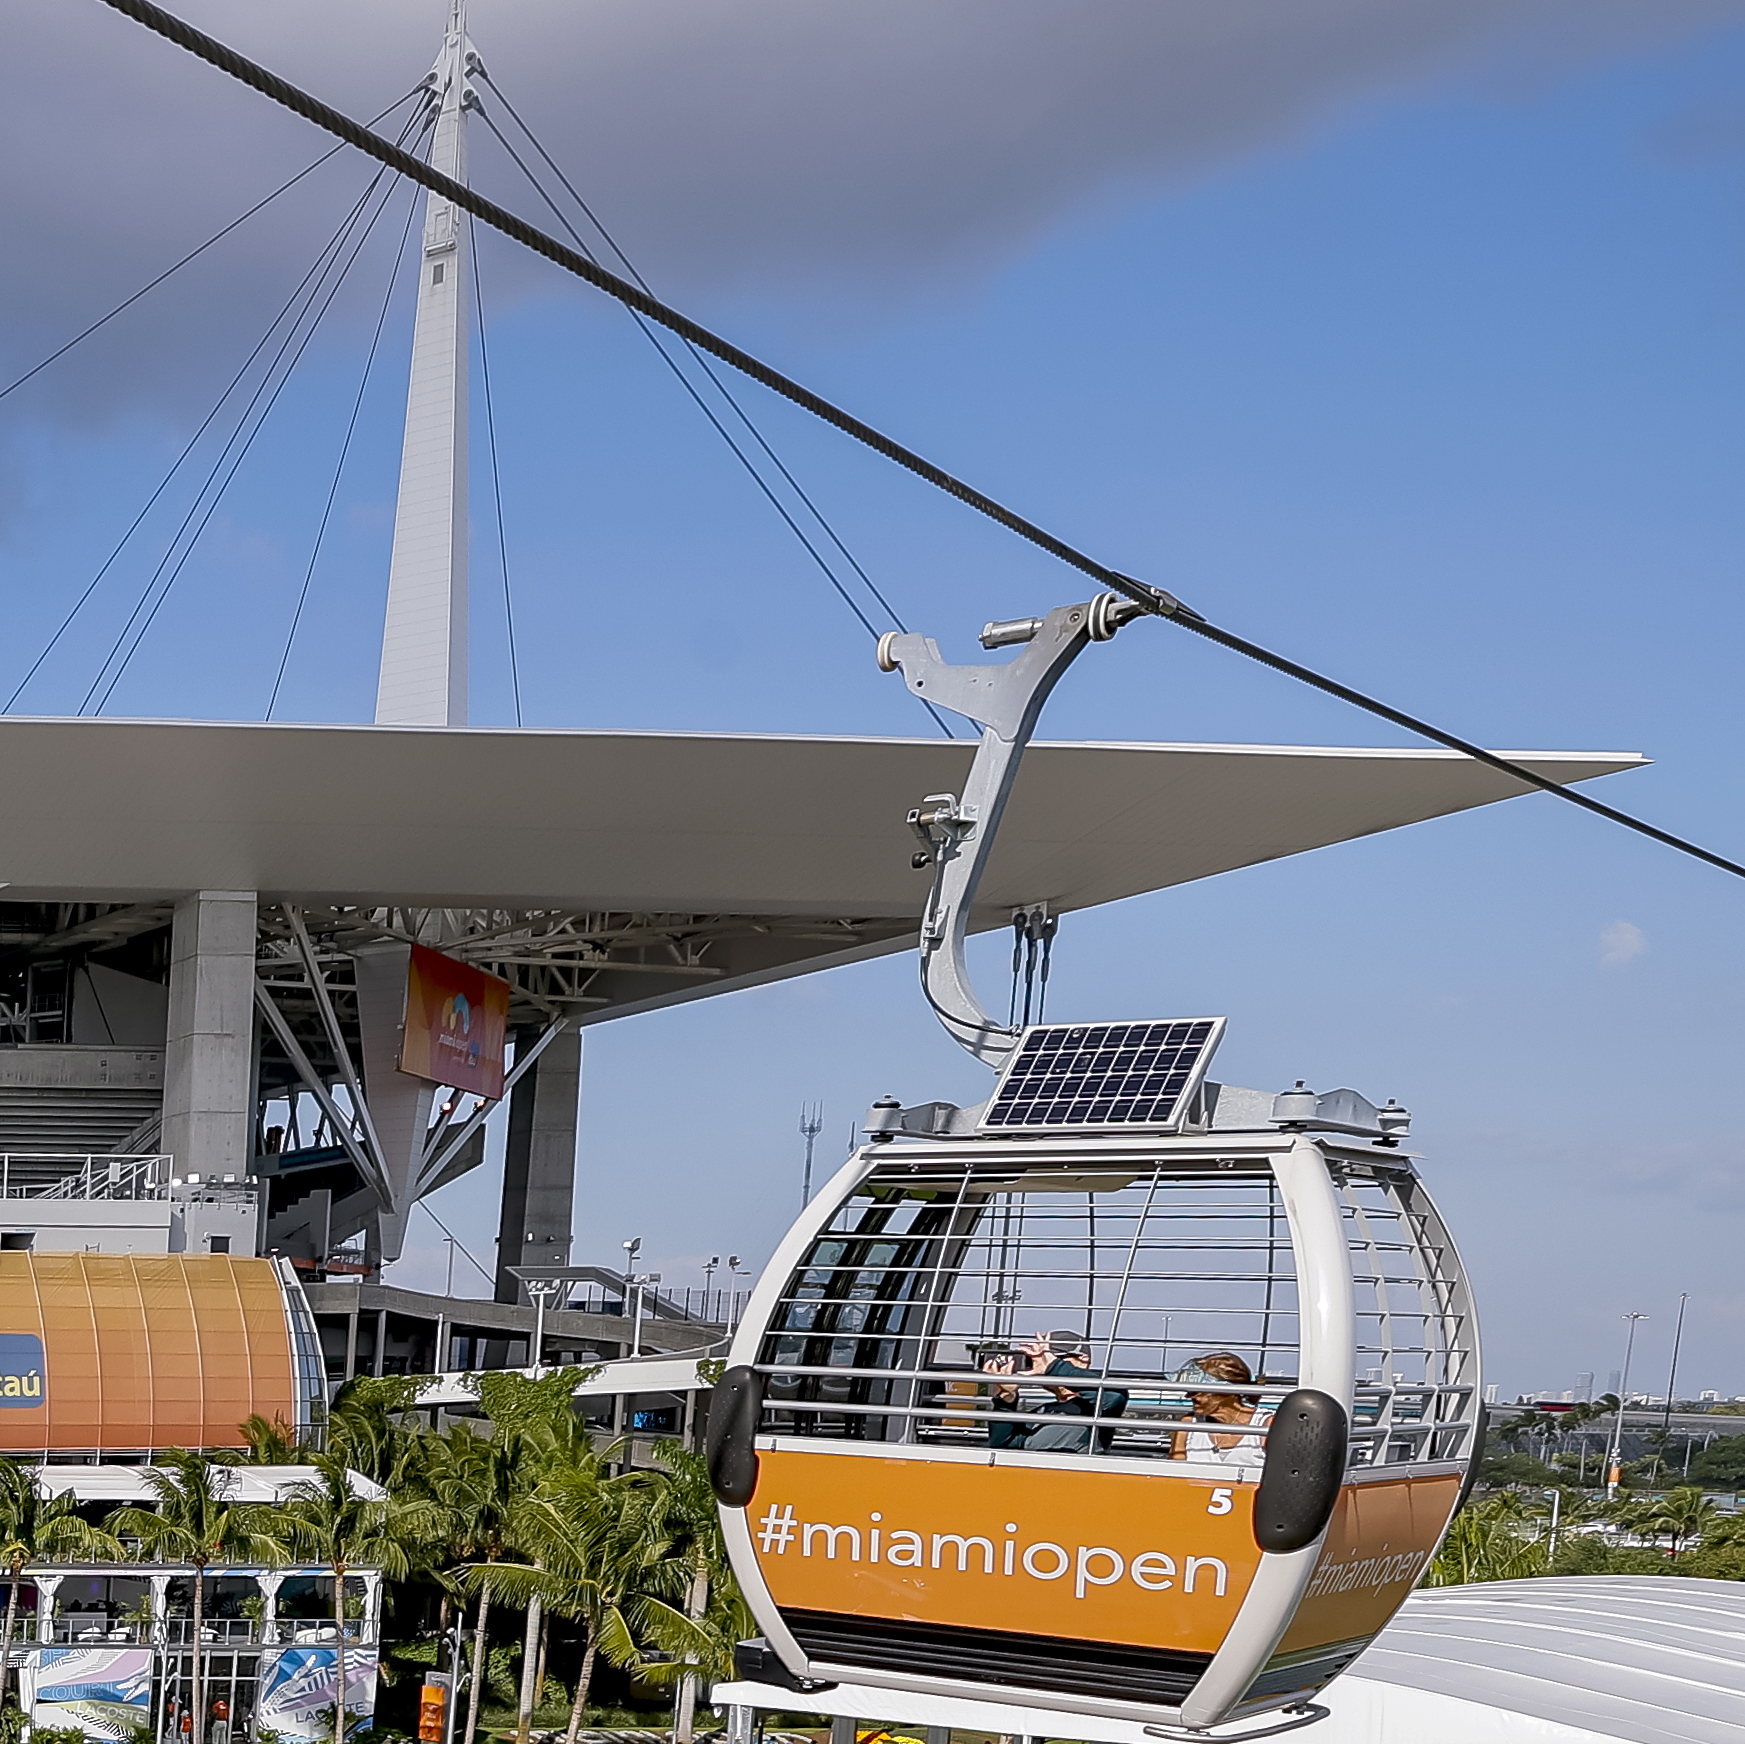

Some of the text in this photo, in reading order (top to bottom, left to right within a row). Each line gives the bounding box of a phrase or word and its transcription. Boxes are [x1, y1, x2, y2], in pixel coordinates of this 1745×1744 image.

[1206, 1488, 1234, 1515] 5
[757, 1502, 1229, 1599] #miamiopen
[1305, 1543, 1425, 1598] #miamiopen
[76, 1701, 147, 1724] LACOSTE
[295, 1701, 365, 1723] LACTE
